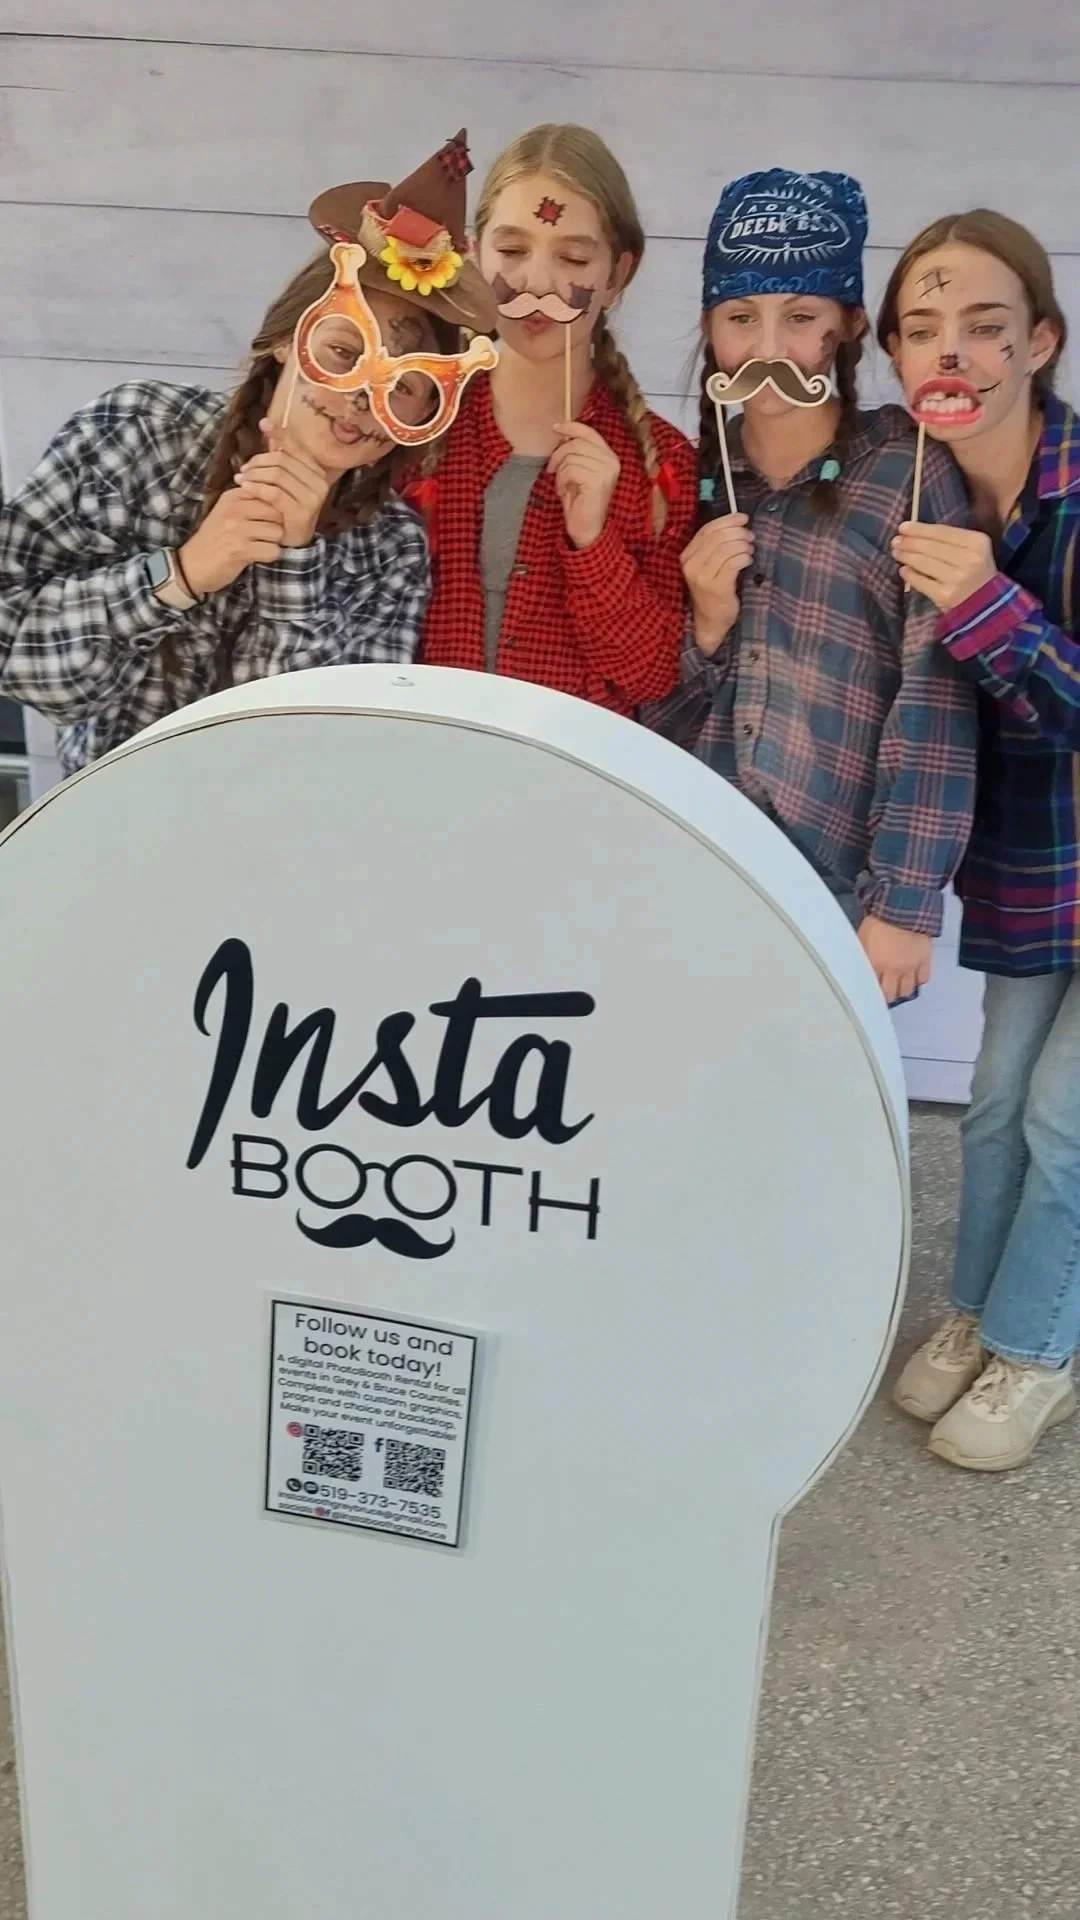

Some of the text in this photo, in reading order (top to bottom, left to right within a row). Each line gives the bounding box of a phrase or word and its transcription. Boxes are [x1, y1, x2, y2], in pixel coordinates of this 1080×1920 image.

[187, 938, 595, 1169] Insta
[231, 1133, 600, 1239] BOOTH
[295, 1313, 453, 1357] Follow us and
[288, 1356, 324, 1369] digital
[395, 1374, 432, 1389] Rental
[434, 1382, 450, 1392] for
[452, 1387, 466, 1396] all
[304, 1336, 441, 1379] book today!
[278, 1377, 334, 1395] Complete
[337, 1388, 361, 1400] with
[363, 1393, 407, 1408] custom
[279, 1367, 317, 1380] events
[319, 1372, 330, 1381] in
[332, 1375, 360, 1389] Grey
[362, 1380, 371, 1389] &
[373, 1382, 407, 1396] Bruce
[280, 1401, 311, 1414] Make
[313, 1408, 339, 1418] your
[341, 1413, 373, 1426] event
[282, 1391, 316, 1404] props
[318, 1397, 341, 1408] and
[343, 1401, 382, 1415] choice
[384, 1408, 396, 1417] of
[320, 1484, 442, 1519] 519-373-7535
